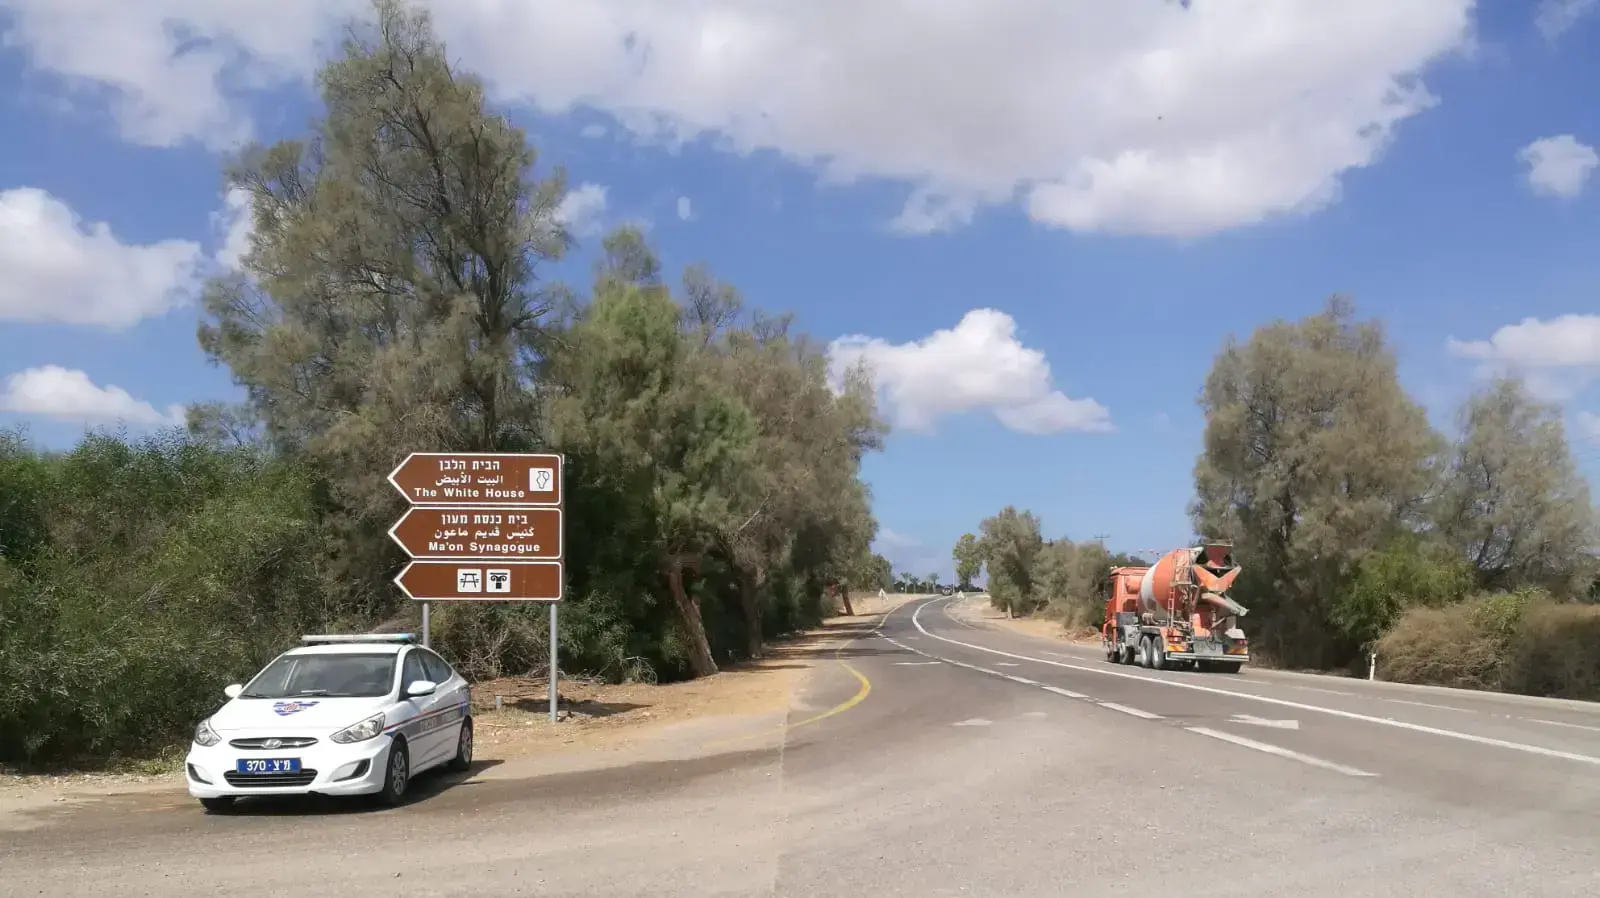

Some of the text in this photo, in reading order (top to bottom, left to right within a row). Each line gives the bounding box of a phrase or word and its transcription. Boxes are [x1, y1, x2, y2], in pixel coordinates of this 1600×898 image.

[439, 459, 500, 471] הבית הלבן
[477, 475, 504, 486] البيت
[414, 487, 525, 498] The White House
[441, 514, 528, 525] בית כנסת מעון
[434, 527, 469, 540] ماعون
[475, 526, 500, 540] قديم
[428, 541, 541, 554] Ma'on Synagogue
[246, 760, 266, 772] 370
